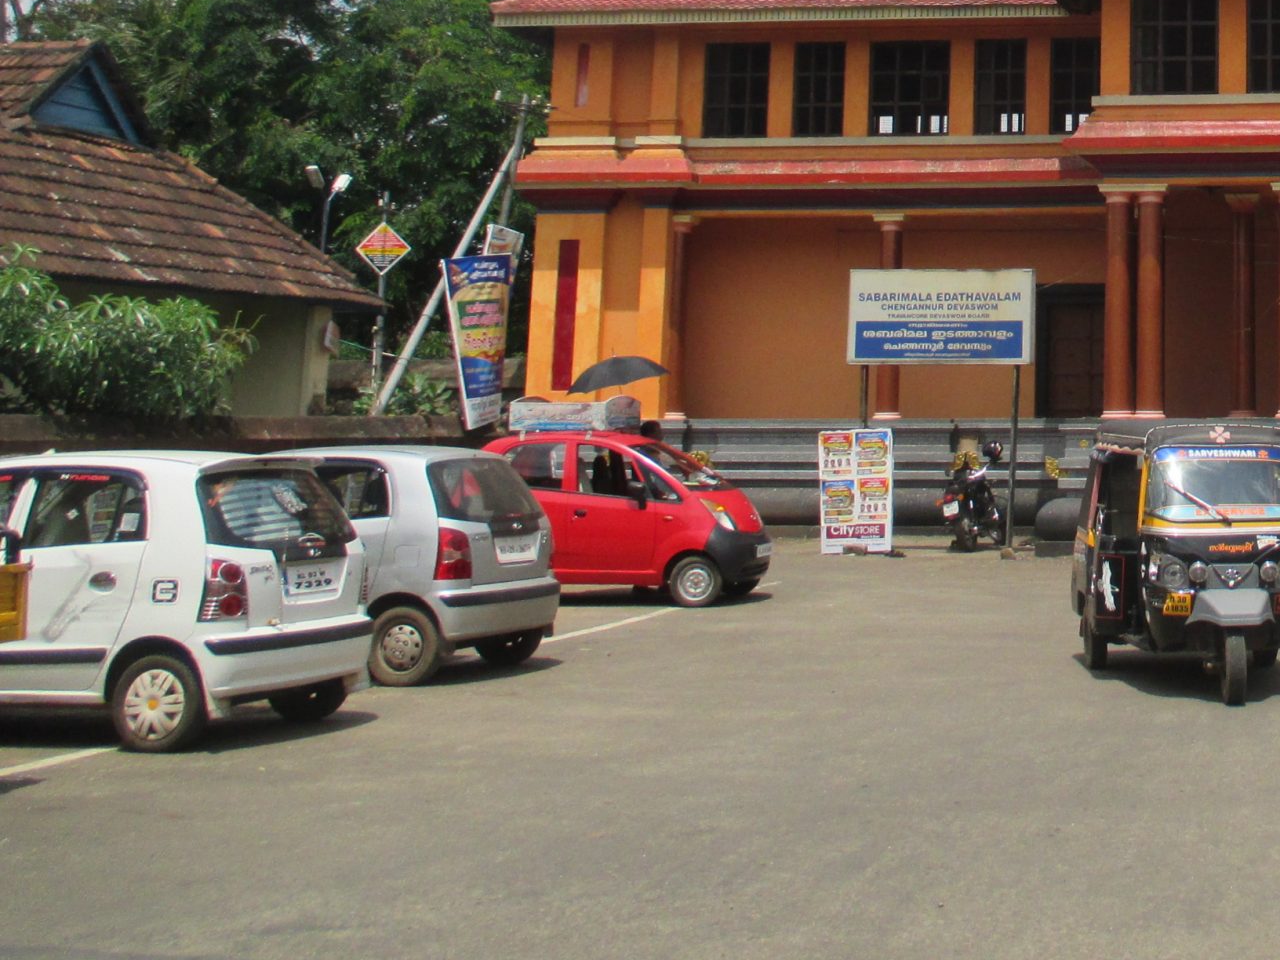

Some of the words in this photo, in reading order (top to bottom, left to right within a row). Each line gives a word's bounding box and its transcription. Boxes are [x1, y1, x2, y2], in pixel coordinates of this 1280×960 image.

[858, 292, 932, 302] SABARIMALA
[936, 292, 1021, 302] EDATHAVALAM
[881, 303, 944, 311] CHENGANNUR
[947, 303, 998, 311] DEVASWOM
[863, 328, 927, 338] ശബരിമല
[931, 330, 1014, 340] ഇടത്താവളം
[1188, 449, 1256, 458] SARVESHWARI
[831, 525, 855, 537] City
[855, 525, 880, 535] STORE
[294, 578, 332, 589] 7329
